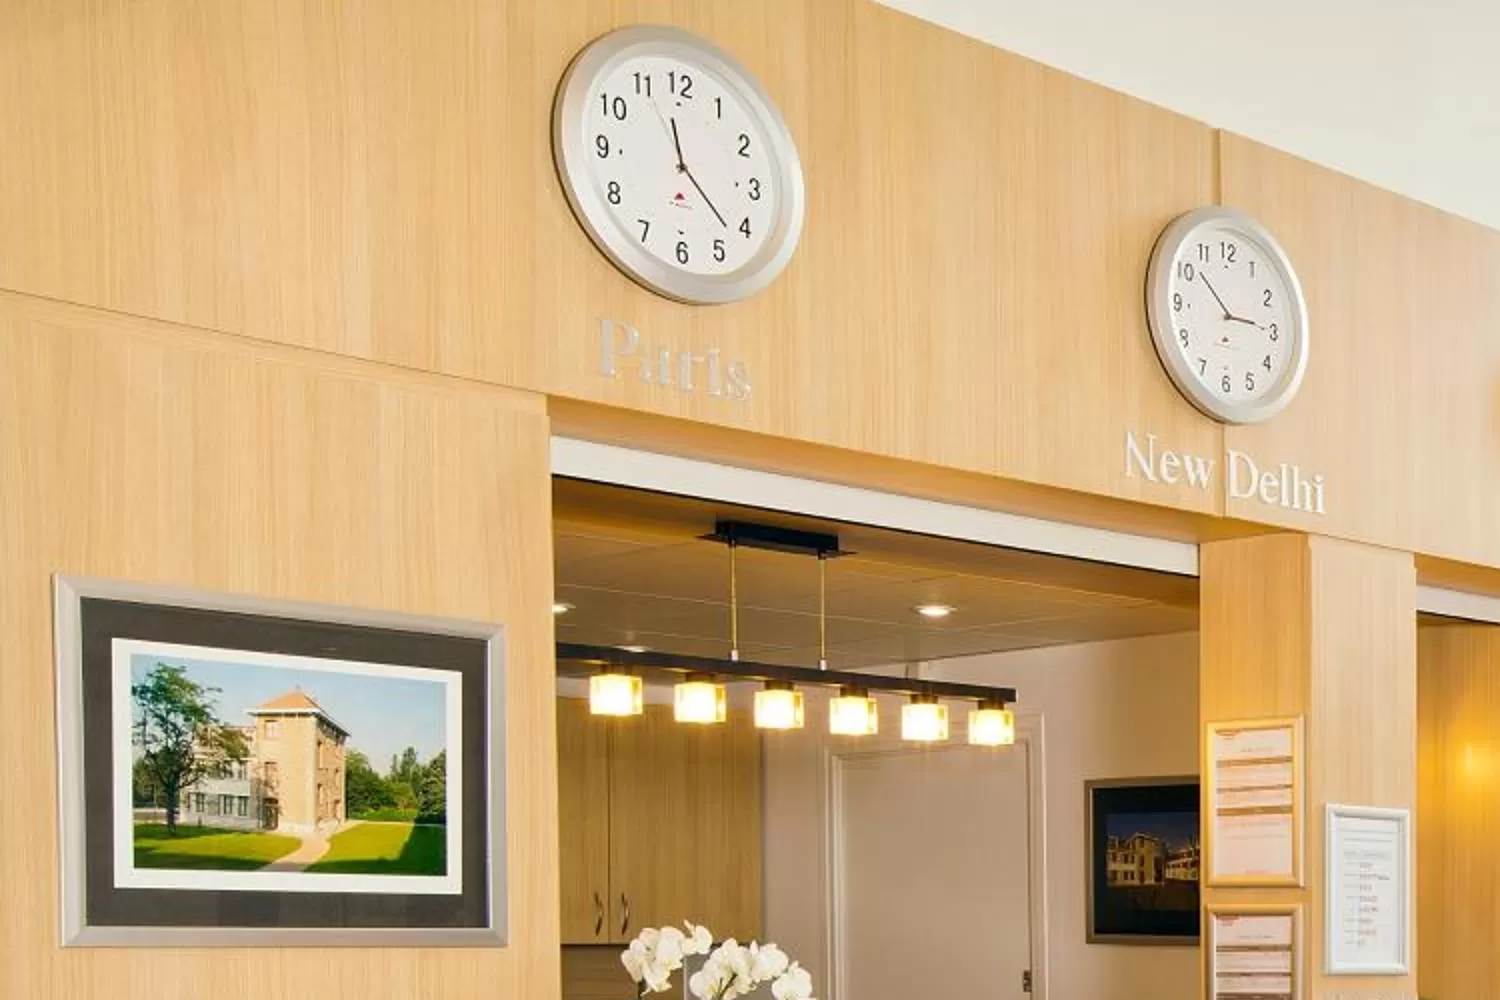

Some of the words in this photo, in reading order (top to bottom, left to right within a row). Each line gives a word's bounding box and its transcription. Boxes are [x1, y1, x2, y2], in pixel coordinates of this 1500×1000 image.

[633, 71, 651, 98] 11
[668, 71, 693, 99] 12
[600, 93, 627, 121] 10
[713, 97, 721, 119] 1
[595, 134, 609, 159] 9
[737, 133, 750, 158] 2
[607, 181, 621, 205] 8
[748, 177, 761, 201] 3
[637, 219, 650, 243] 7
[739, 216, 752, 239] 4
[675, 241, 689, 264] 6
[713, 239, 725, 262] 5
[1198, 243, 1210, 263] 11
[1220, 241, 1237, 263] 12
[1177, 261, 1194, 282] 10
[1248, 261, 1256, 278] 1
[1173, 292, 1182, 312] 9
[1263, 289, 1273, 308] 2
[1269, 323, 1279, 341] 3
[599, 317, 753, 400] Paris
[1198, 357, 1207, 376] 7
[1263, 355, 1272, 372] 4
[1222, 375, 1231, 393] 6
[1245, 372, 1255, 391] 5
[1125, 431, 1214, 490] New
[1228, 451, 1325, 513] Delhi
